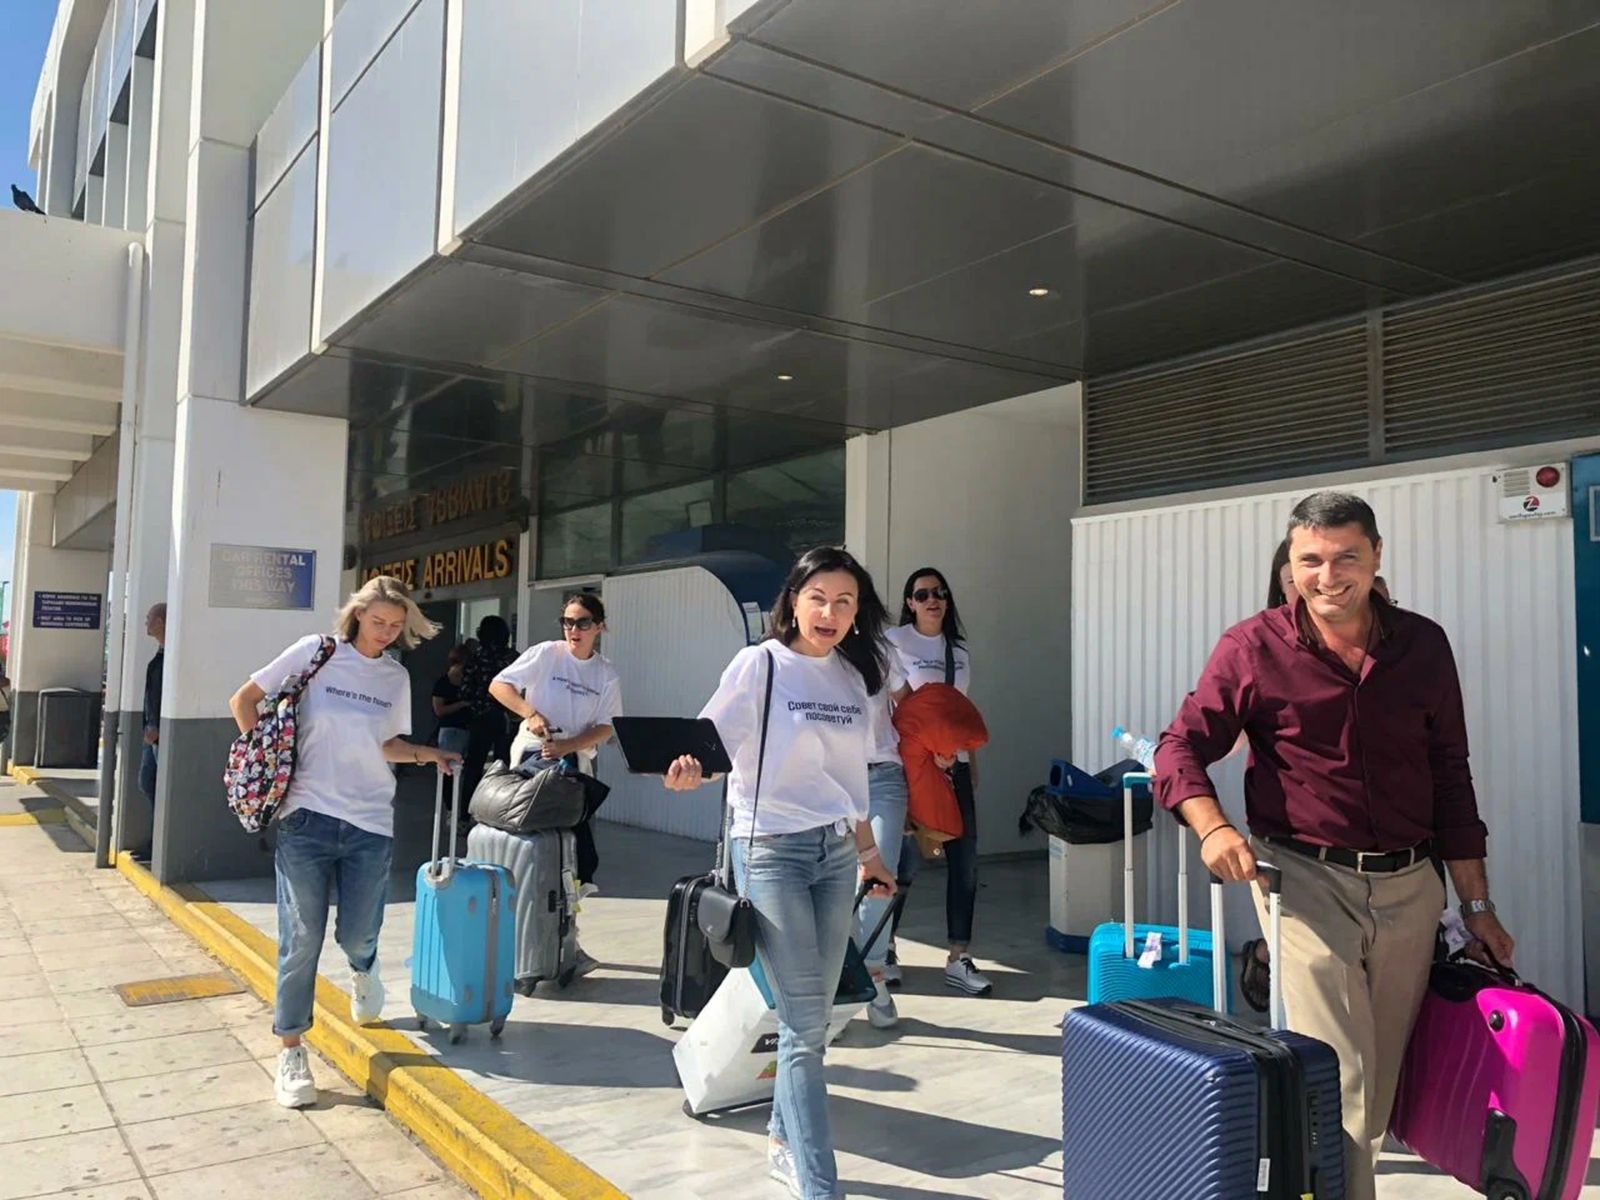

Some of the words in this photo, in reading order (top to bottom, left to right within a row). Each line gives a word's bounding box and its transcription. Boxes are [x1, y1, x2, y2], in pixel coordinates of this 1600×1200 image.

[223, 550, 249, 562] CAR
[255, 552, 306, 566] RENTAL
[423, 540, 511, 589] ARRIVALS
[266, 579, 296, 593] WAY
[788, 700, 816, 711] Совет
[818, 701, 839, 712] свой
[806, 711, 853, 725] посоветуй
